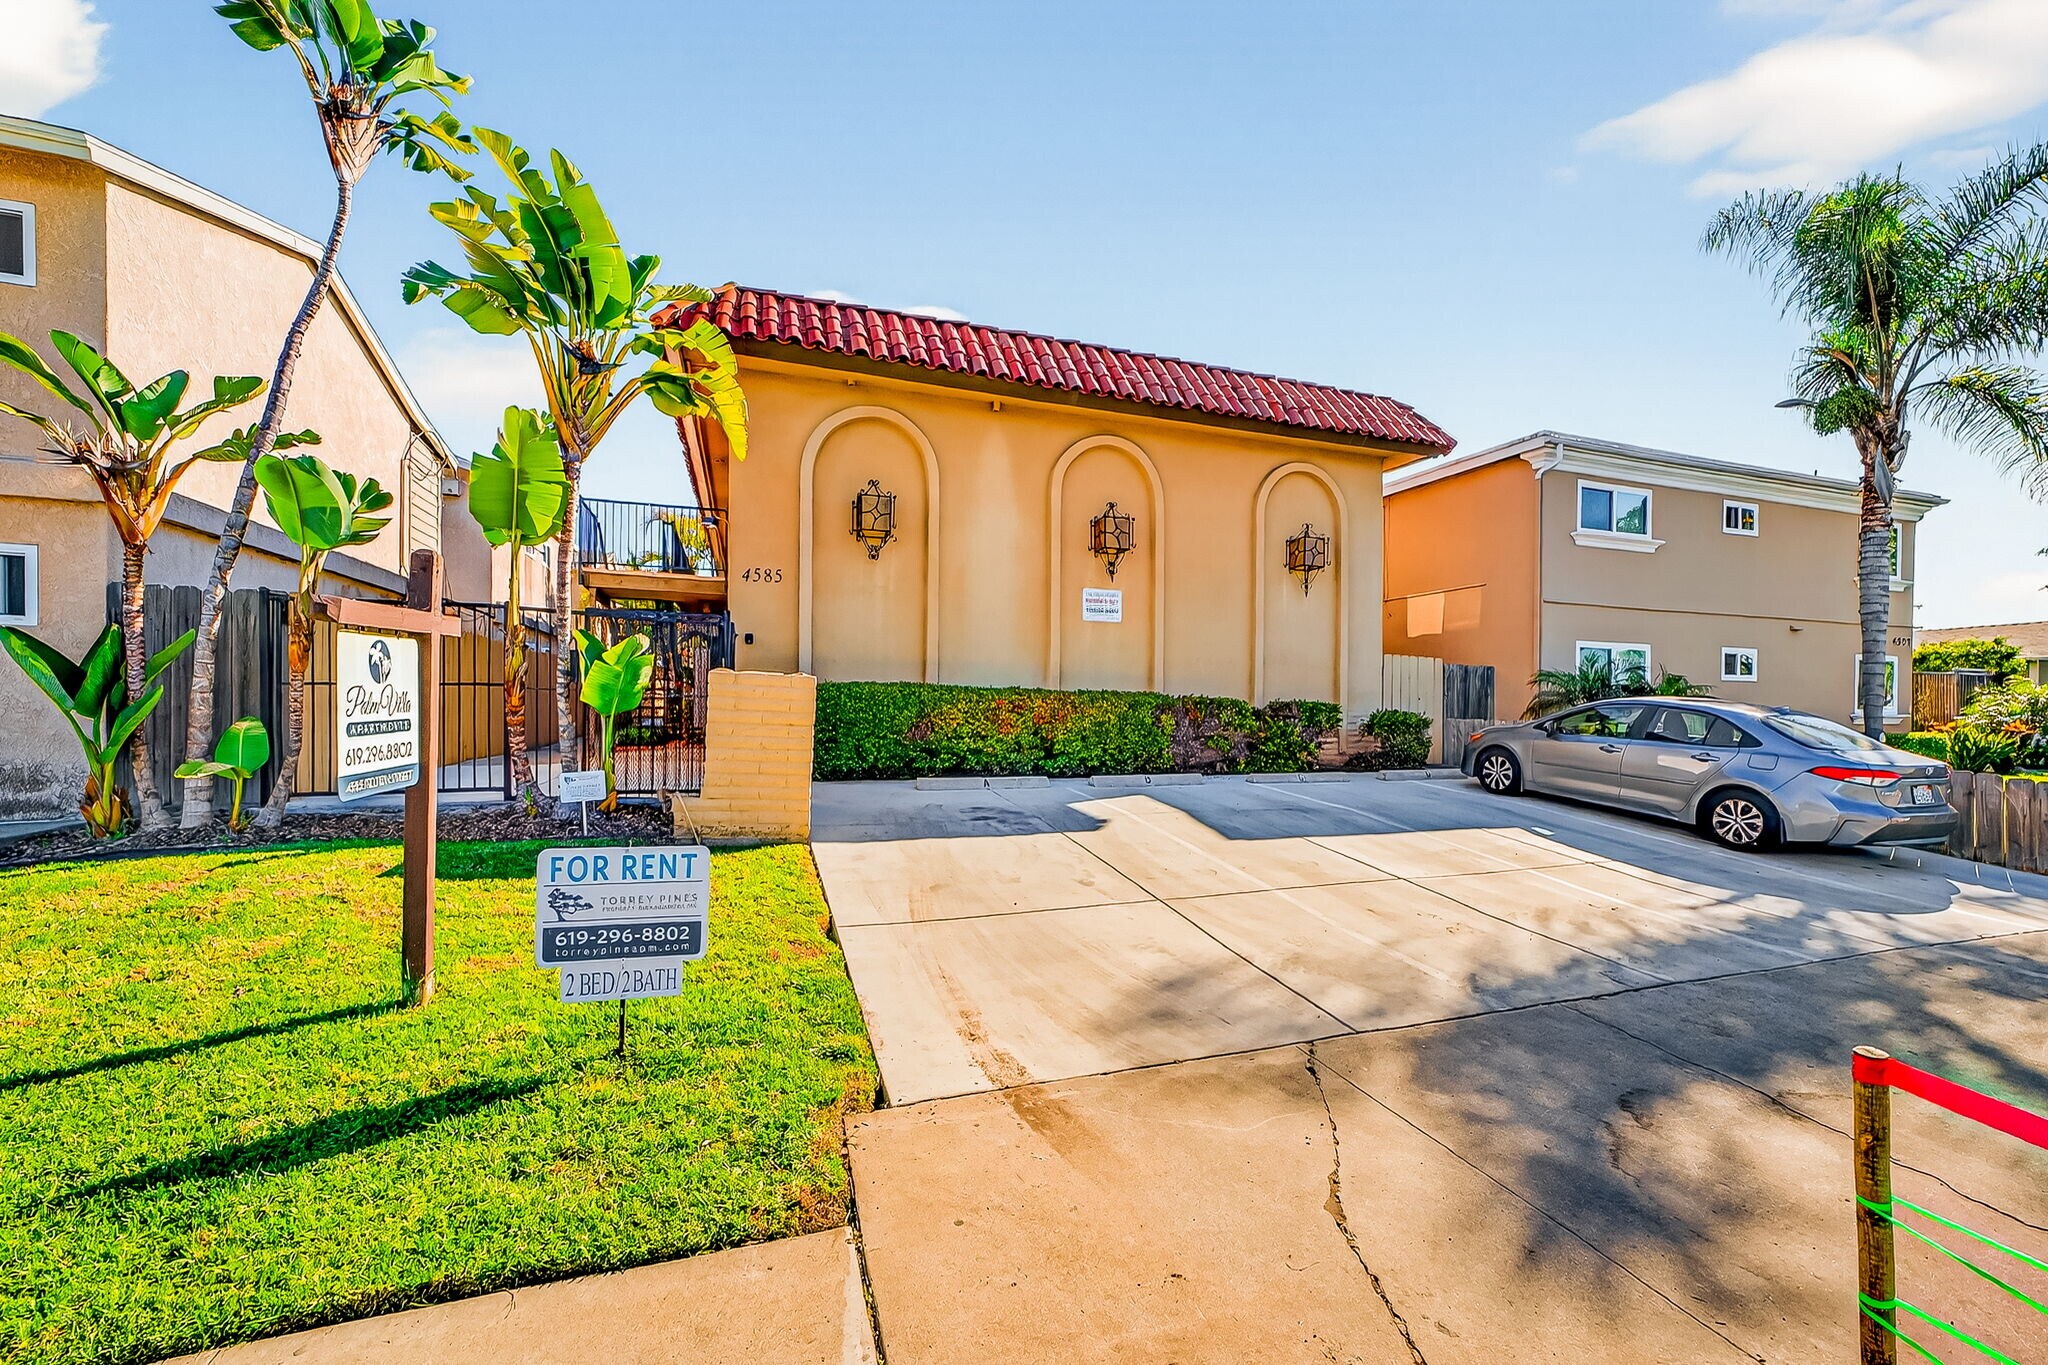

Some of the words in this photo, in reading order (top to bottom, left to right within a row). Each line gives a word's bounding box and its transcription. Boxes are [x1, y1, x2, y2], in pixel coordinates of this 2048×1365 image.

[742, 567, 783, 583] 4585
[345, 685, 381, 717] Palm
[380, 683, 411, 716] Villa
[345, 741, 413, 766] 619.296.8802
[550, 855, 609, 882] FOR
[621, 853, 698, 880] RENT
[600, 895, 654, 906] TORREY
[659, 893, 698, 904] PINES
[555, 926, 690, 946] 619-296-8802
[565, 973, 575, 997] 2
